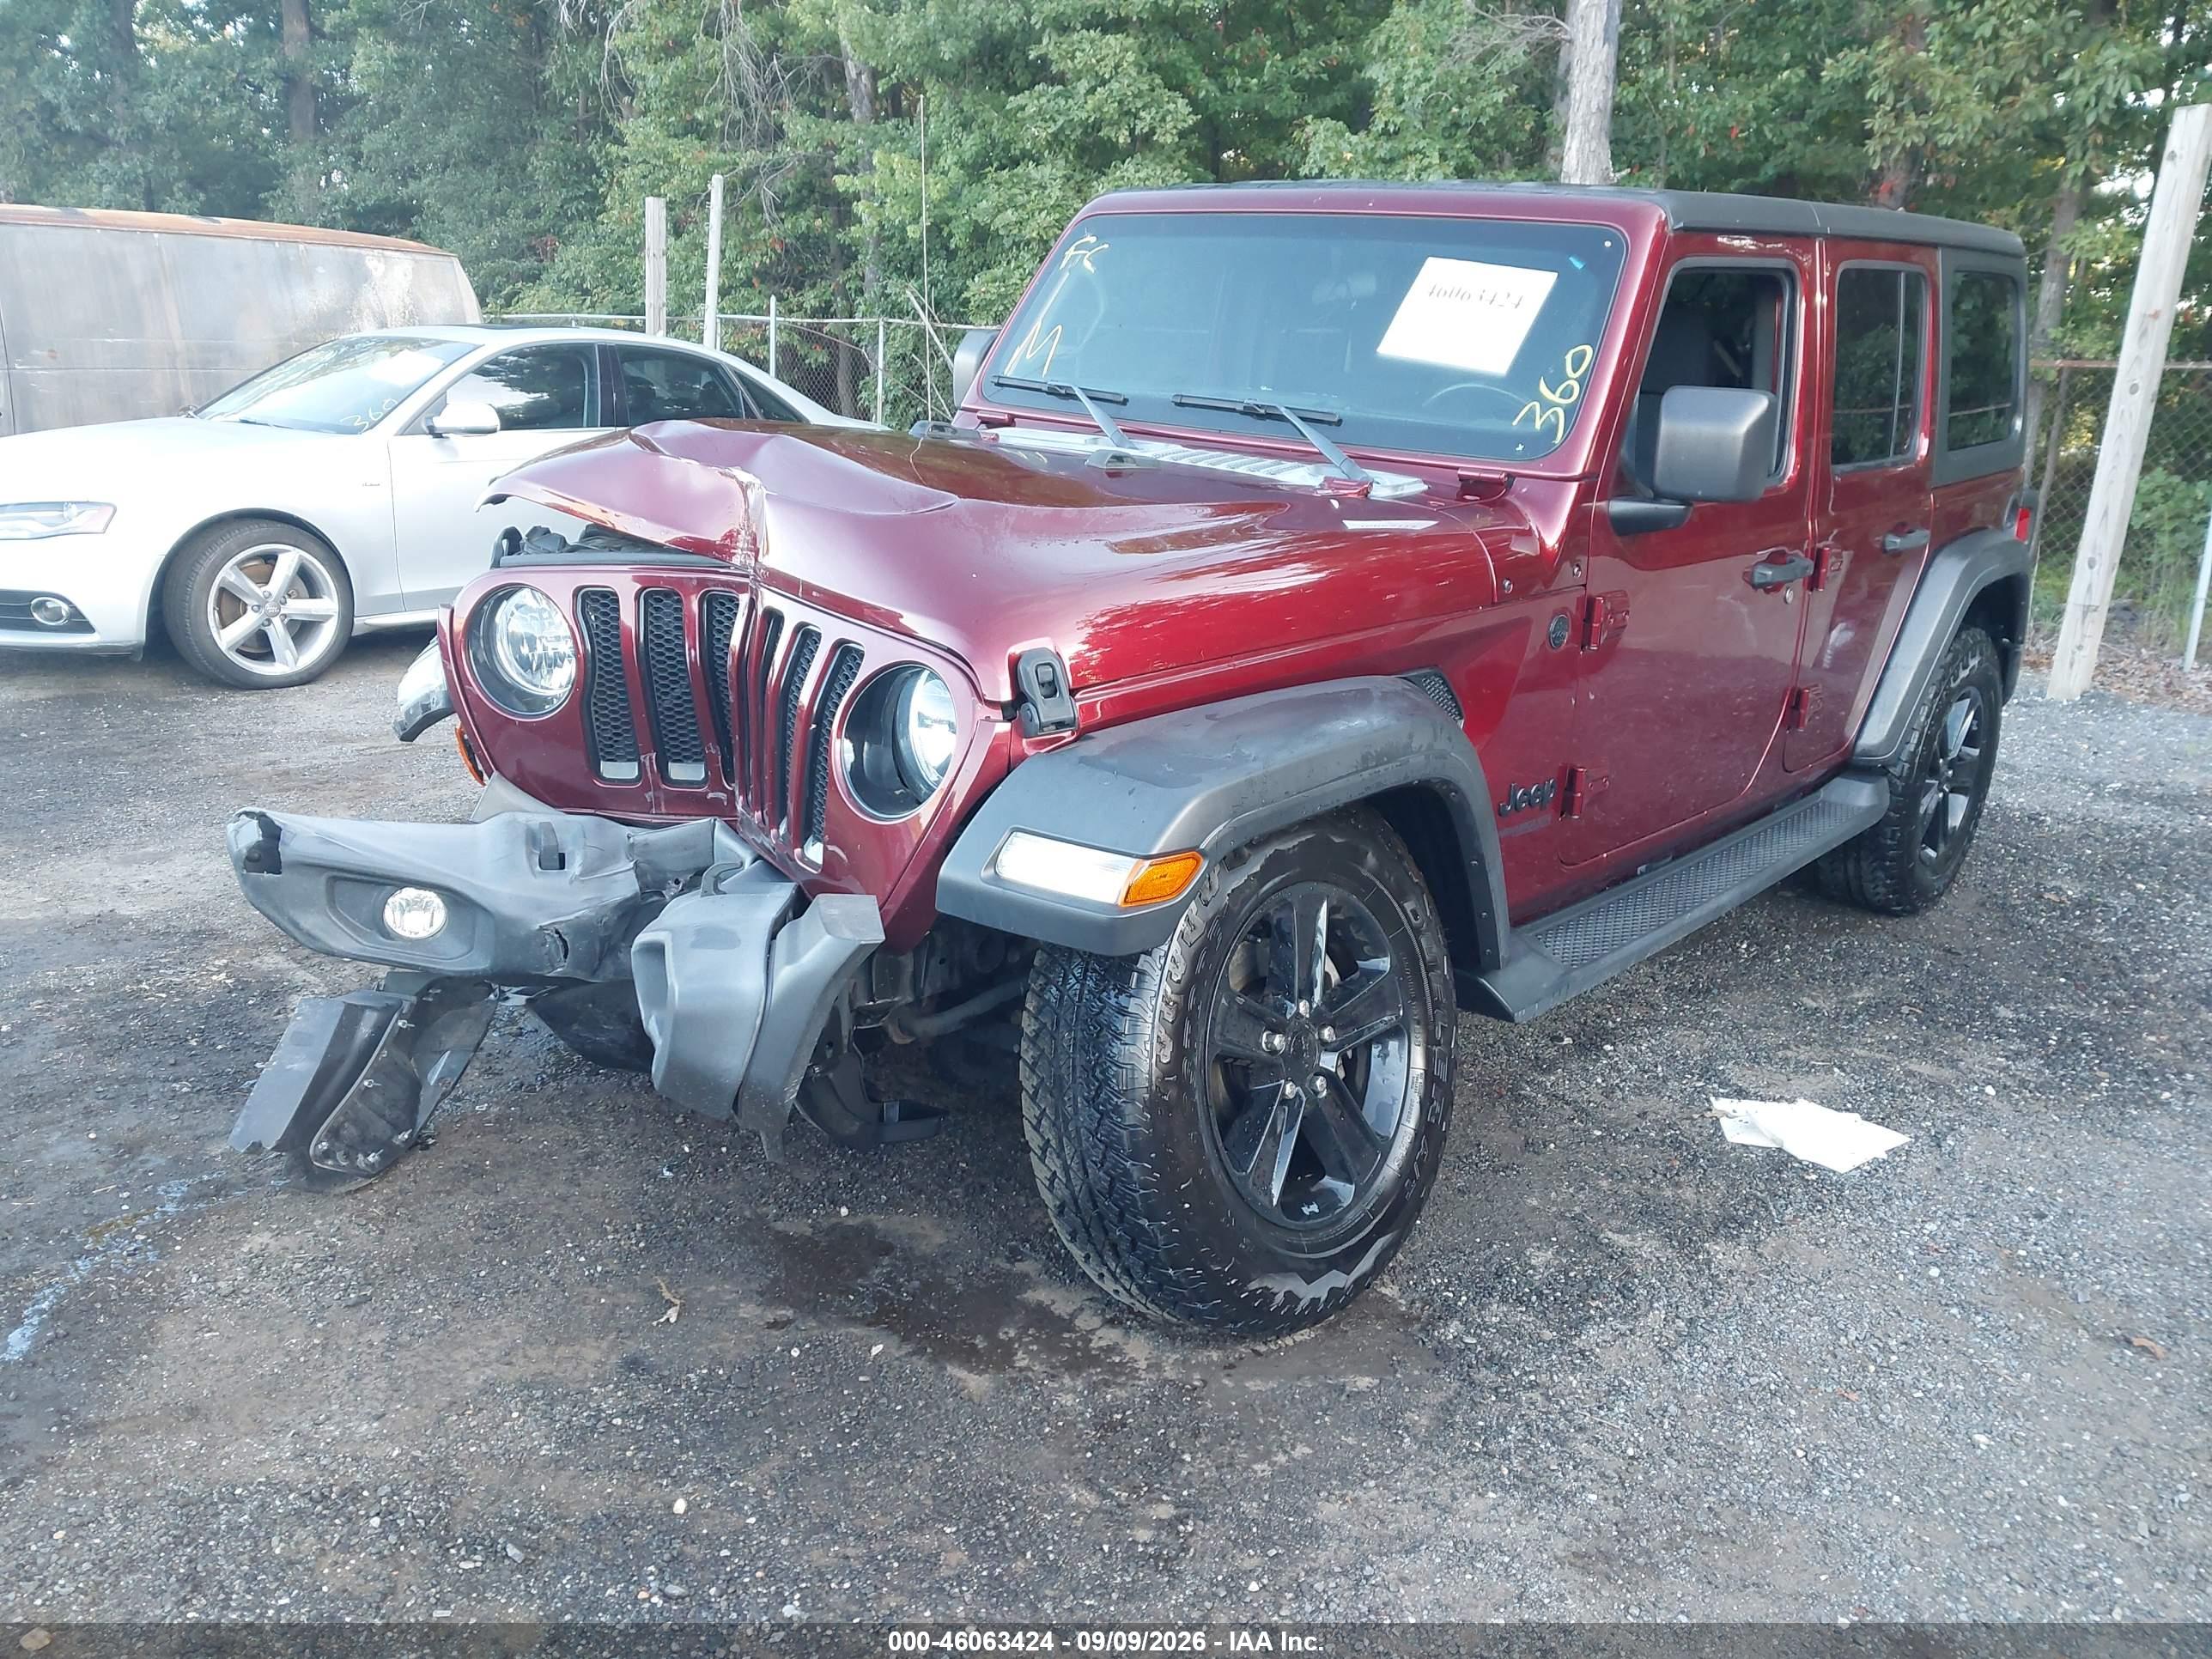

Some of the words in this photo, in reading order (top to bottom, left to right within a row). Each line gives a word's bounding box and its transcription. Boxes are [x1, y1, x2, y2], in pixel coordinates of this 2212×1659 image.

[1511, 343, 1594, 444] 360
[338, 398, 398, 434] 360
[1498, 778, 1557, 817] Jeep
